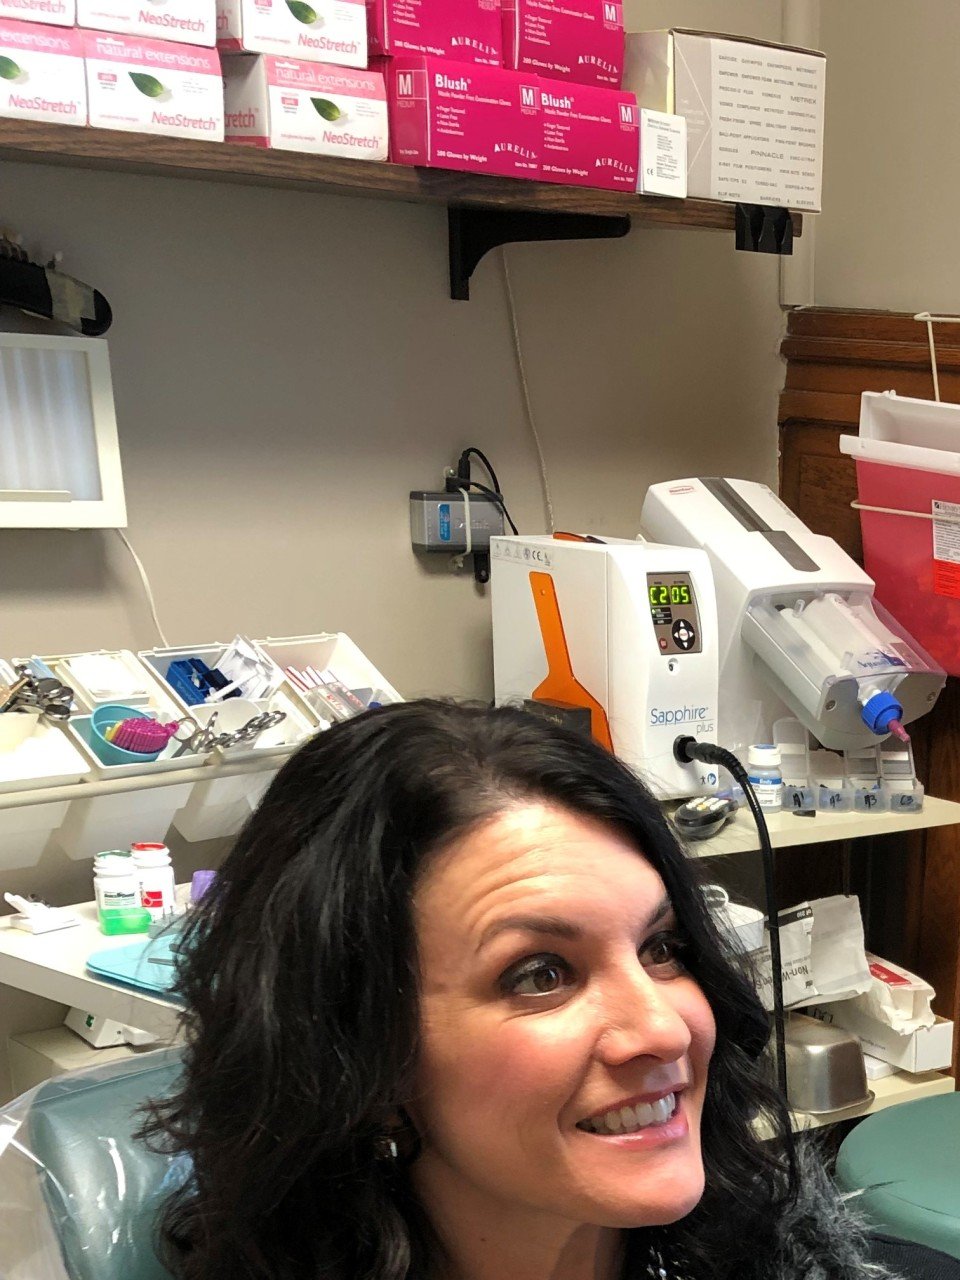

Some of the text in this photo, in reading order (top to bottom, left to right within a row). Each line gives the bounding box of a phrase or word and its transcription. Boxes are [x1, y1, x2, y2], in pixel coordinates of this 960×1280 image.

[139, 10, 205, 32] NeoStretch
[605, 4, 616, 22] M
[298, 33, 357, 54] NeoStretch
[451, 36, 498, 55] AURELIA
[97, 43, 211, 69] natural extensions
[578, 55, 618, 73] AURELIA
[275, 68, 315, 84] natural
[318, 74, 375, 91] extensions
[399, 74, 412, 95] M
[435, 73, 467, 91] Blush
[9, 94, 77, 114] NeoStretch
[522, 88, 534, 106] M
[541, 93, 571, 109] Blush
[152, 111, 216, 131] NeoStretch
[621, 105, 632, 123] M
[323, 131, 379, 149] NeoStretch
[494, 143, 538, 159] AURELIA
[750, 150, 784, 160] PINNACLE
[595, 157, 634, 174] AURELIA
[651, 705, 706, 725] Sapphire
[696, 722, 714, 735] plus
